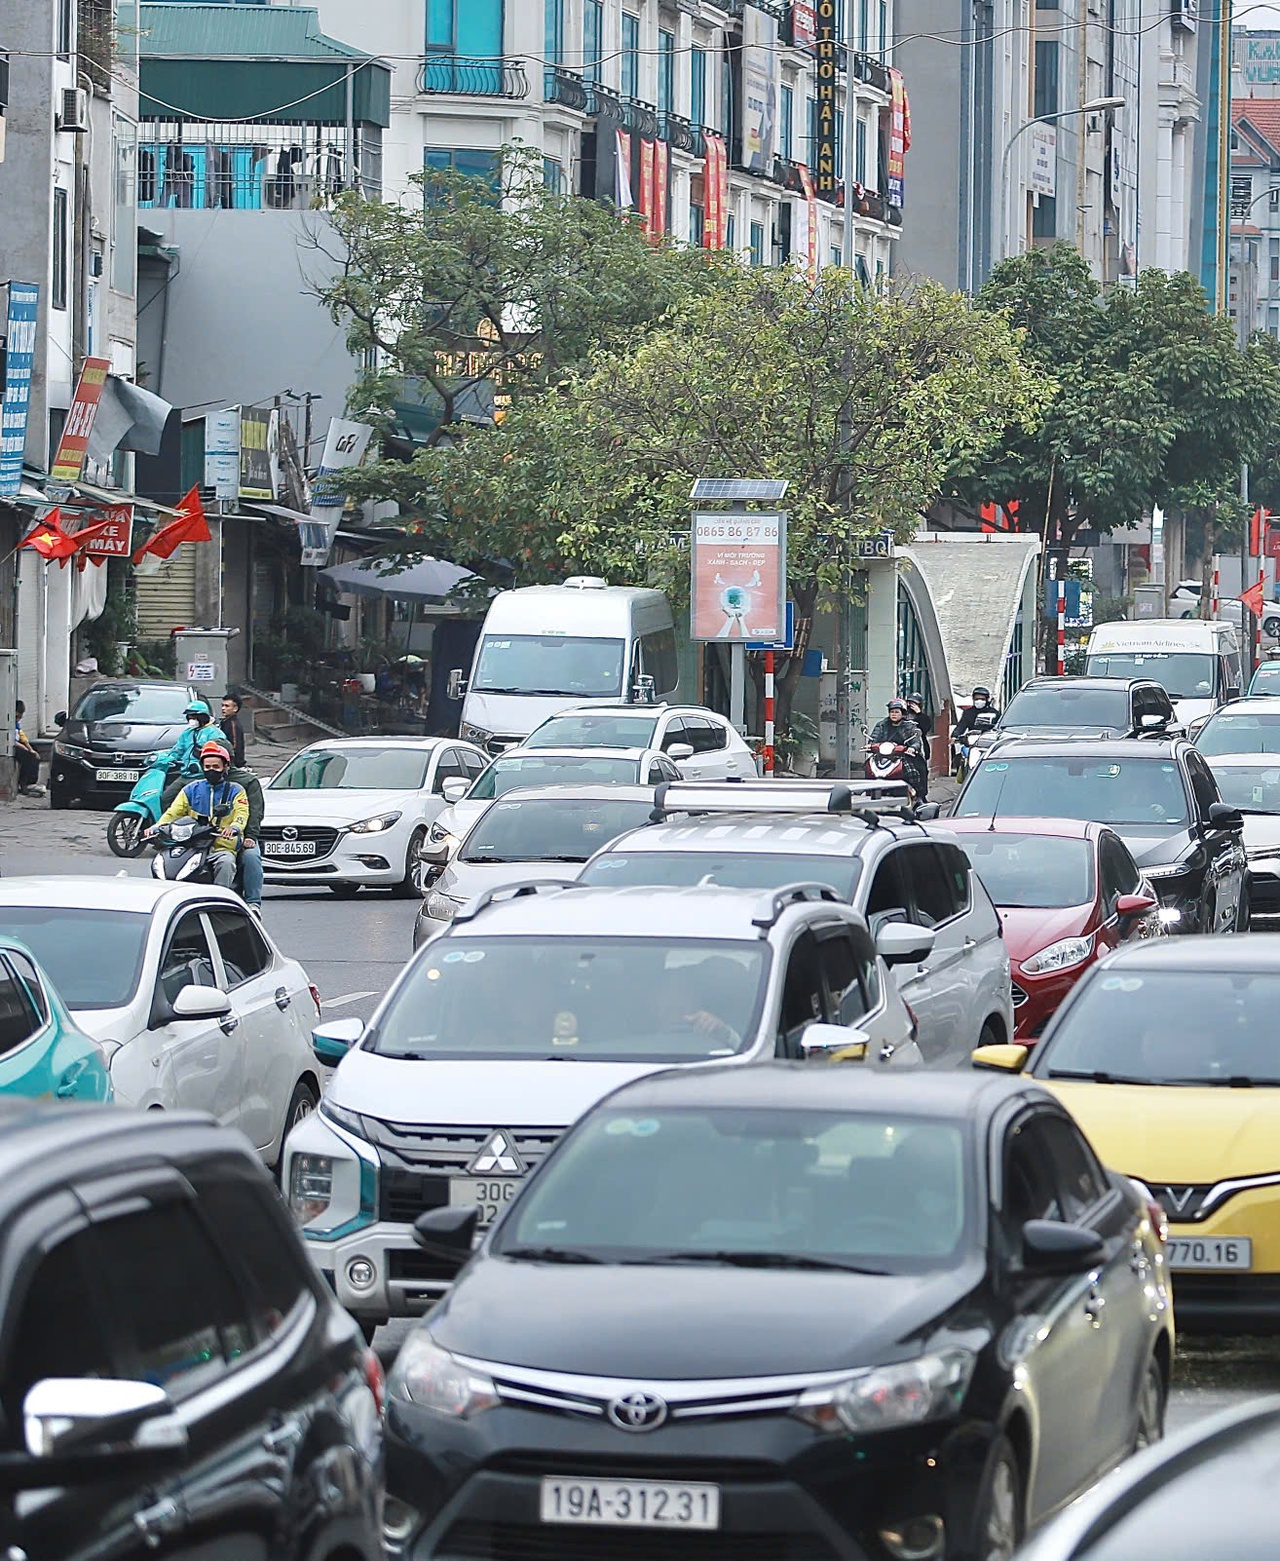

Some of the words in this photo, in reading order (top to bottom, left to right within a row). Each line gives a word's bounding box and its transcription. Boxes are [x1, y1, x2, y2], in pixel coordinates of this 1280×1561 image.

[820, 85, 832, 136] HẢI
[820, 147, 832, 190] ANH
[697, 526, 725, 537] 0865
[728, 526, 742, 537] 86
[746, 526, 760, 537] 87
[764, 526, 778, 537] 86
[90, 538, 125, 551] MÁY
[1115, 640, 1152, 648] Vietnam
[1152, 640, 1185, 648] Airlines
[265, 843, 315, 854] 30E-845.69
[553, 1486, 709, 1522] 19A-312.31
